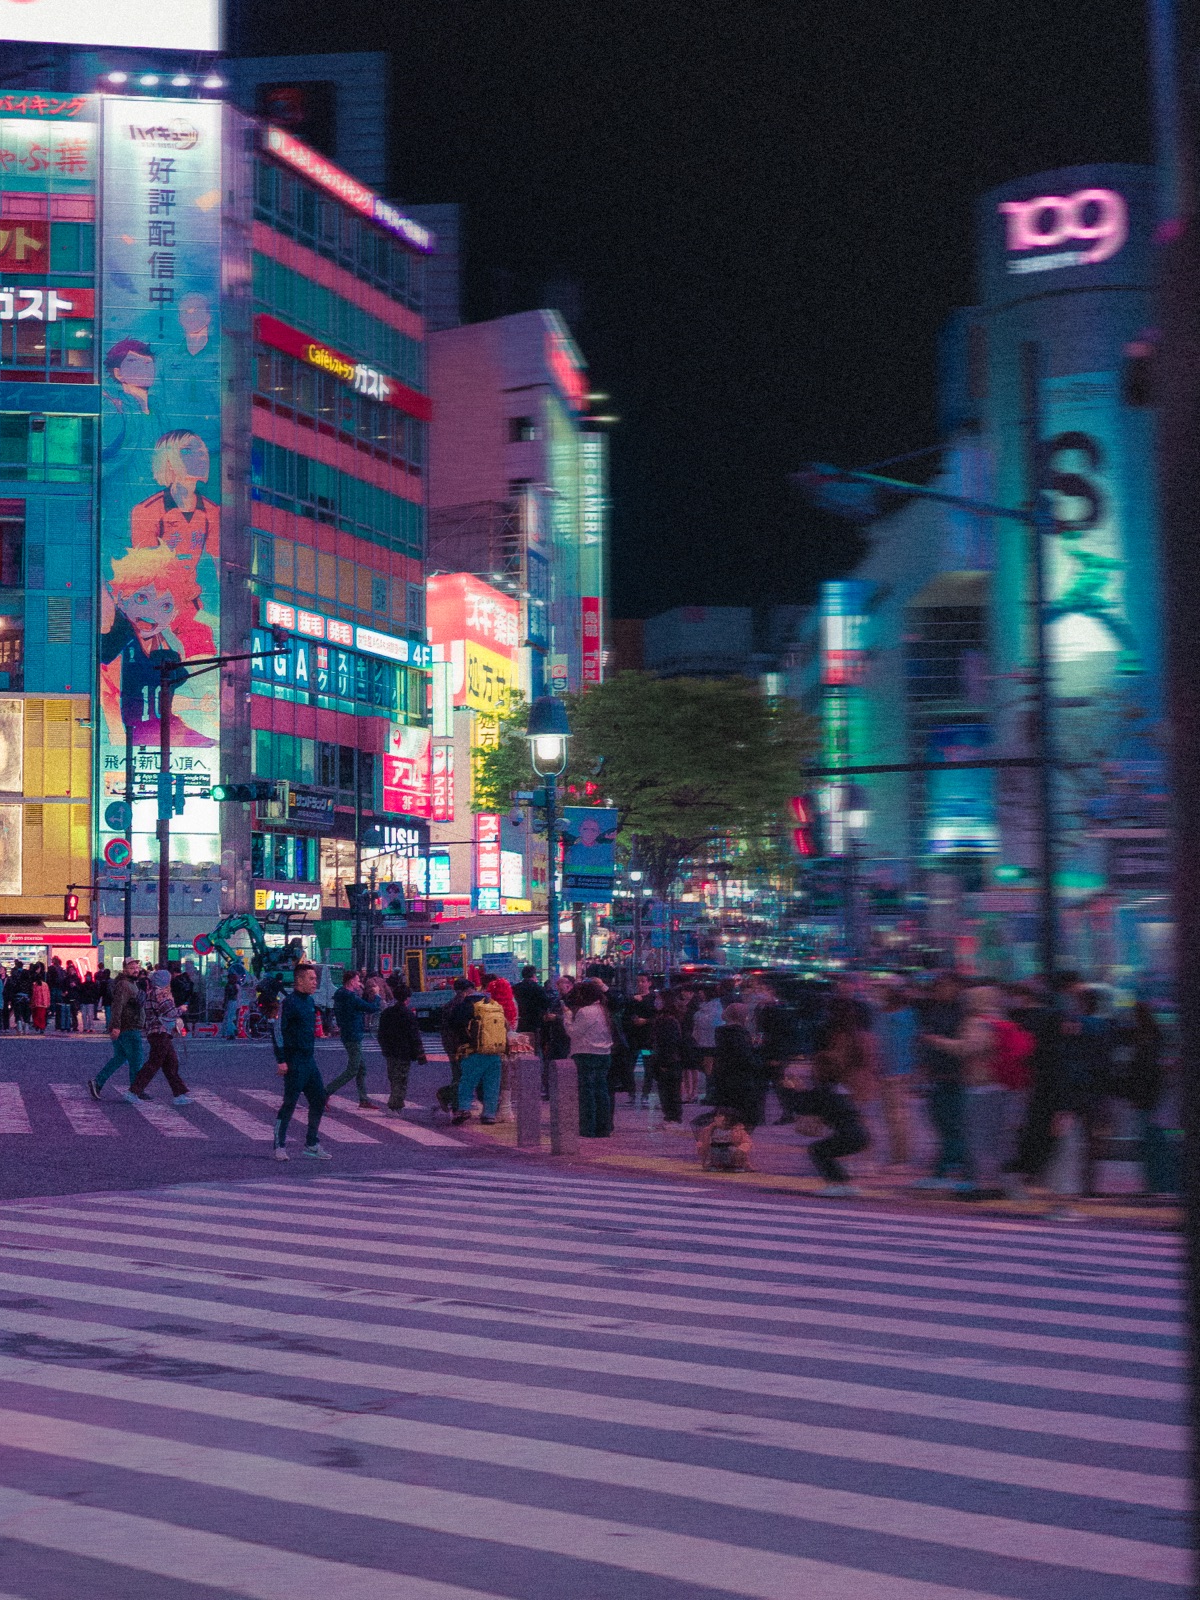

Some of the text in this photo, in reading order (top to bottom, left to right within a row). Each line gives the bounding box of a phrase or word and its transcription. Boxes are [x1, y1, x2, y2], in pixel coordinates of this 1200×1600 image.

[997, 188, 1129, 264] 109
[355, 363, 390, 402] ガスト
[412, 644, 431, 668] 4F
[375, 825, 419, 857] USH
[274, 892, 321, 911] サンドラッグ
